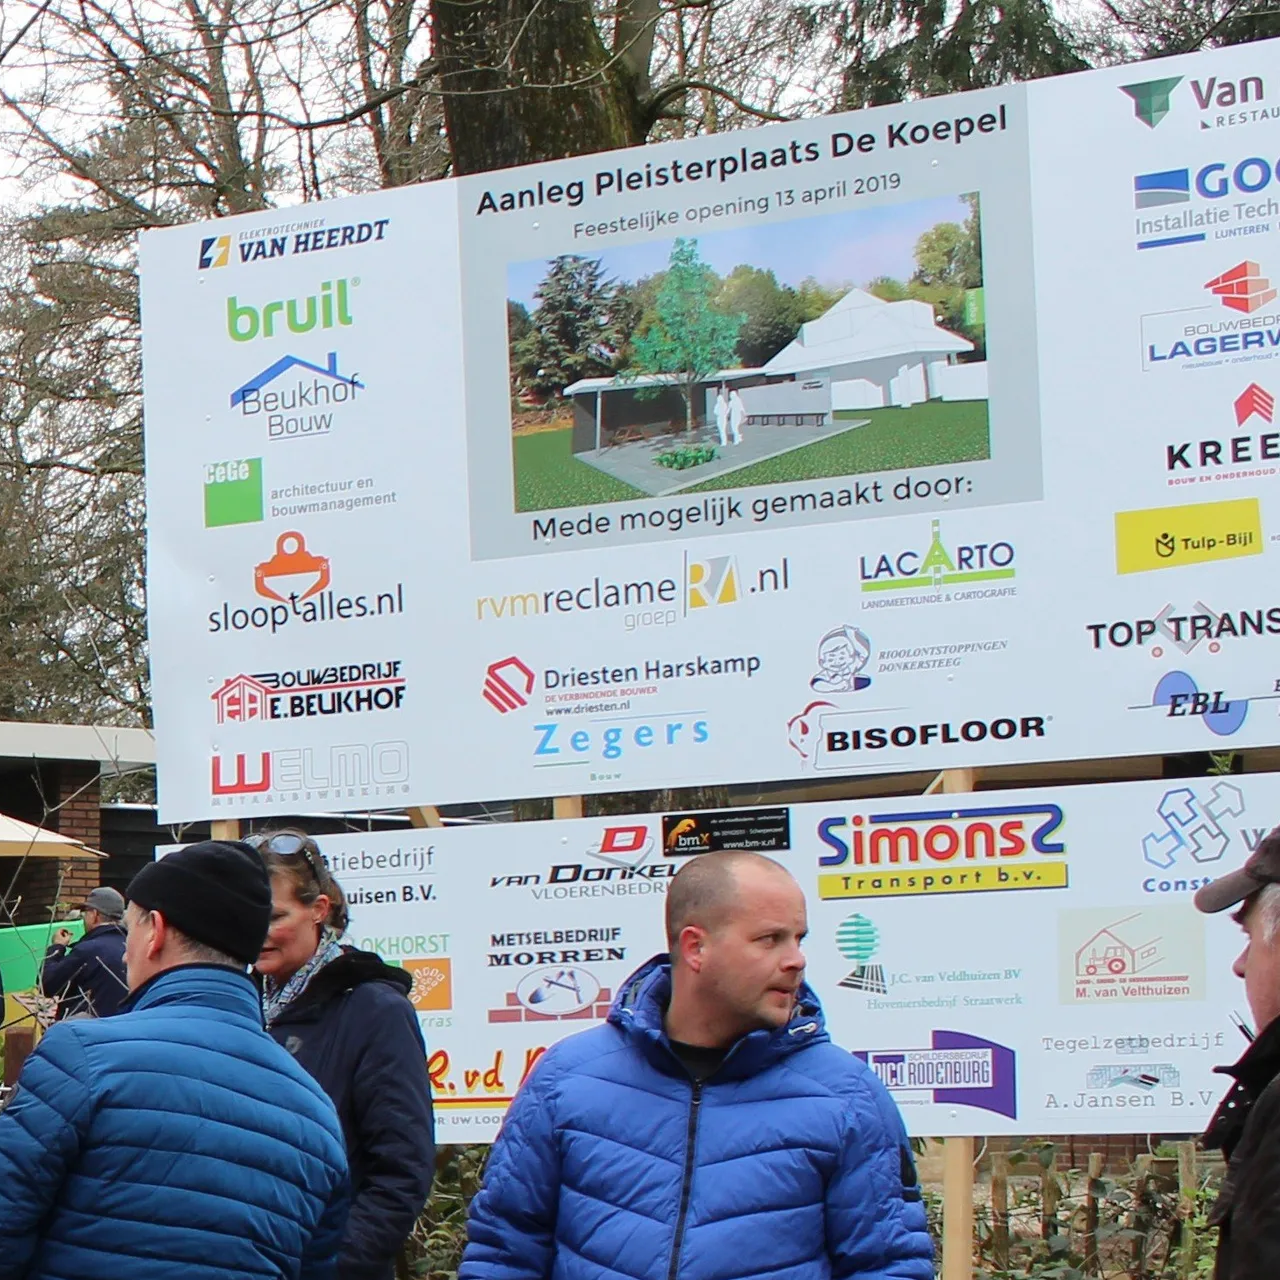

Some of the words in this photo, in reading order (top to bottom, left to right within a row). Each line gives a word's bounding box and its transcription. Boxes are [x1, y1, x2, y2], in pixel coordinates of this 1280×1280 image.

[1190, 75, 1264, 111] Van
[476, 180, 585, 215] Aanleg
[596, 140, 820, 197] Pleisterplaats
[831, 132, 876, 158] De
[887, 104, 1007, 149] Koepel
[1195, 157, 1280, 199] GO
[574, 210, 680, 239] Feestelijke
[685, 196, 770, 222] opening
[776, 189, 794, 207] 13
[801, 180, 847, 205] april
[854, 173, 901, 195] 2019
[1136, 206, 1230, 235] Installatie
[1215, 223, 1271, 240] LUNTEREN
[239, 236, 286, 263] VAN
[292, 218, 390, 255] HEERDT
[227, 278, 353, 342] bruil
[241, 373, 360, 415] Beukhof
[268, 413, 333, 438] Bouw
[271, 479, 354, 500] architectuur
[356, 476, 374, 489] en
[271, 491, 398, 517] bouwmanagement
[532, 512, 610, 541] Mede
[620, 496, 742, 531] mogelijk
[752, 481, 883, 522] gemaakt
[893, 476, 973, 501] door:
[1181, 531, 1254, 551] Tulp-Bijl
[859, 538, 1015, 581] LACARTO
[208, 583, 404, 634] slooptalles.nl
[861, 592, 943, 610] LANDMEETKUNDE
[953, 586, 1017, 601] CARTOGRAFIE
[624, 607, 677, 631] groep
[1086, 619, 1157, 650] TOP
[878, 639, 1009, 661] RIOOLONTSTOPPINGEN
[254, 660, 402, 689] BOUWBEDRIJF
[543, 662, 638, 690] Driesten
[644, 655, 762, 682] Harskamp
[878, 656, 962, 674] DONKERSTEEG
[1166, 690, 1230, 718] EBL
[533, 718, 710, 760] Zegers
[826, 715, 1046, 753] BISOFLOOR
[326, 845, 436, 873] tiebedrijf
[841, 870, 982, 891] Transport
[997, 866, 1042, 883] b.v.
[402, 884, 437, 903] B.V.
[490, 927, 622, 948] METSELBEDRIJF
[486, 947, 627, 967] MORREN
[890, 973, 912, 986] J.C.
[915, 974, 935, 984] van
[938, 970, 1002, 983] Veldhuizen
[1003, 969, 1022, 980] BV
[1075, 987, 1091, 998] M.
[1094, 987, 1118, 998] van
[1121, 983, 1191, 997] Velthuizen
[866, 995, 959, 1011] Hoveniersbedrijf
[962, 993, 1023, 1006] Straatwerk
[1042, 1032, 1224, 1053] Tegelzetbedrijf
[908, 1060, 990, 1086] RODENBURG
[1045, 1092, 1156, 1109] A.Jansen
[452, 1115, 472, 1125] UW
